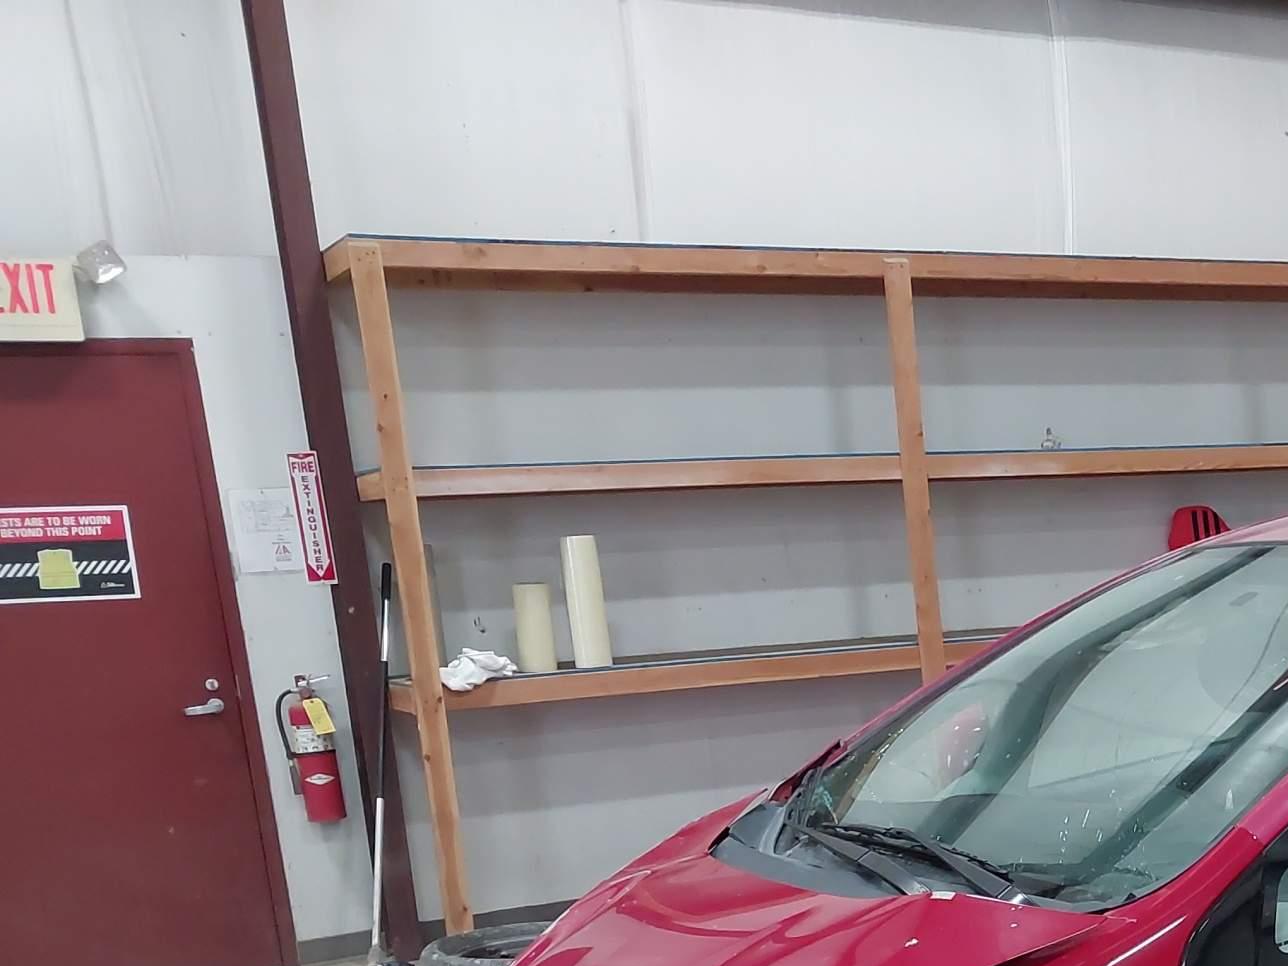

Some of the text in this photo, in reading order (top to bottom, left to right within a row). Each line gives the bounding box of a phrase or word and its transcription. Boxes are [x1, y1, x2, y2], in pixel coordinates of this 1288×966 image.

[0, 262, 56, 314] XIT
[291, 461, 315, 473] FIRE
[0, 518, 21, 527] STS
[46, 516, 60, 526] TO
[62, 516, 76, 526] BE
[77, 515, 111, 525] WORN
[300, 475, 324, 571] EXTINGUISHER
[1, 526, 102, 538] BEYOND THIS POINT
